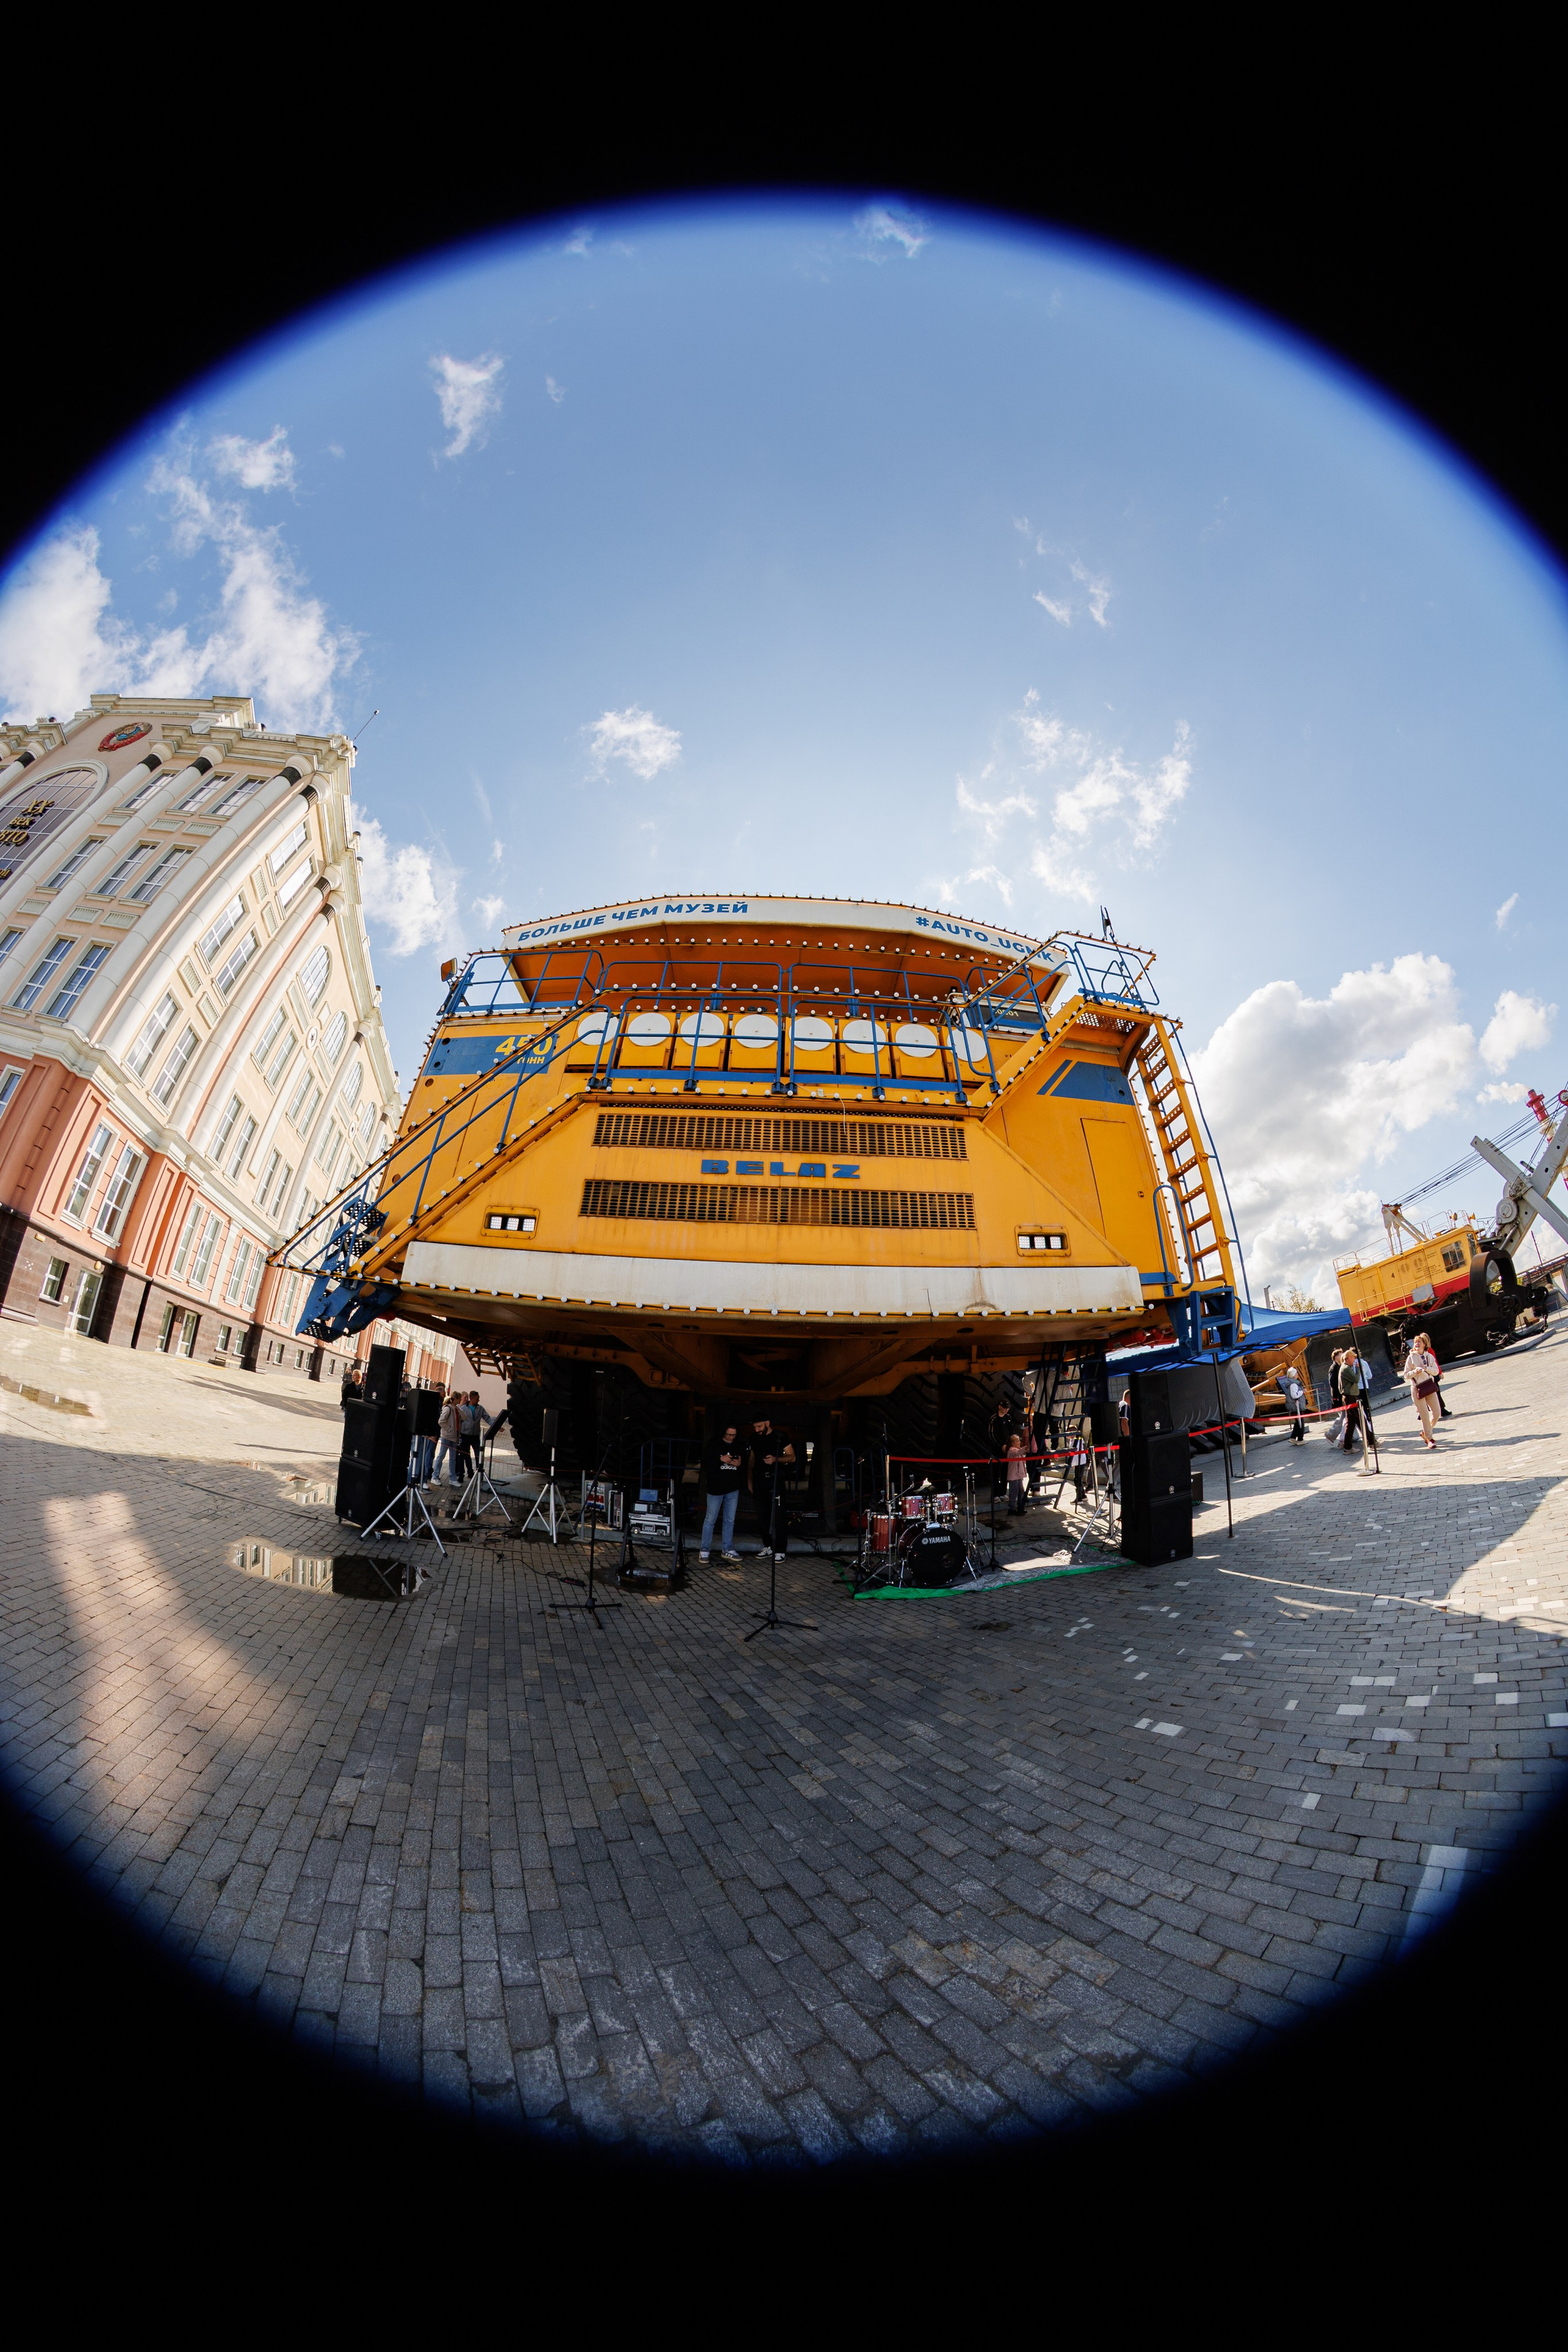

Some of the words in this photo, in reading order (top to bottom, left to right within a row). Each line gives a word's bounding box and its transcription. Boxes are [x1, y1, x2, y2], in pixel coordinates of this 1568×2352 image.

[518, 914, 606, 941] БОЛЬШЕ
[611, 905, 659, 921] ЧЕМ
[664, 901, 748, 914] МУЗЕЙ
[701, 1159, 860, 1179] BELAZ
